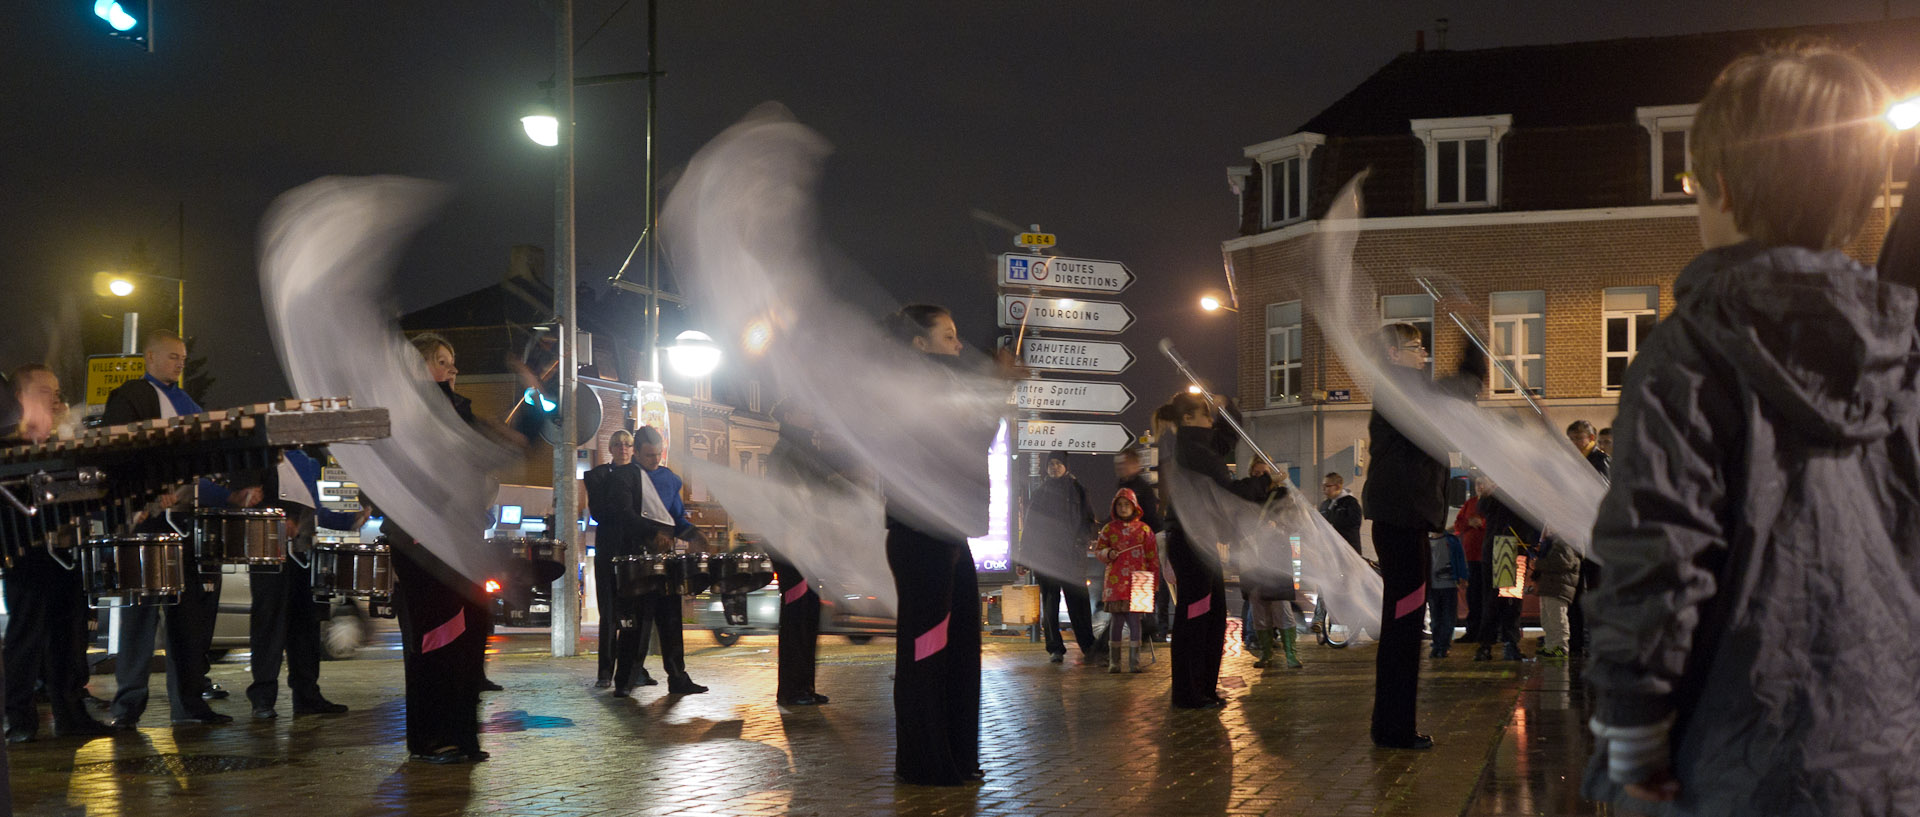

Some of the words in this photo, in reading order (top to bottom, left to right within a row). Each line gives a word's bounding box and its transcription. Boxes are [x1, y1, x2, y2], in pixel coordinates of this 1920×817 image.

[1026, 234, 1033, 244] D
[1036, 234, 1050, 244] 64
[1055, 262, 1095, 274] TOUTES
[1055, 274, 1118, 287] DIRECTIONS
[1034, 307, 1100, 321] TOURCOING
[1030, 342, 1087, 355] SAHUTERIE
[1029, 354, 1099, 367] MACKELLERIE
[92, 362, 113, 372] VILLE
[1050, 385, 1088, 396] Sportif
[1019, 395, 1067, 408] Seigneur
[1027, 424, 1056, 435] GARE
[1017, 438, 1046, 447] ureau
[1051, 438, 1063, 447] de
[1068, 438, 1097, 449] Poste
